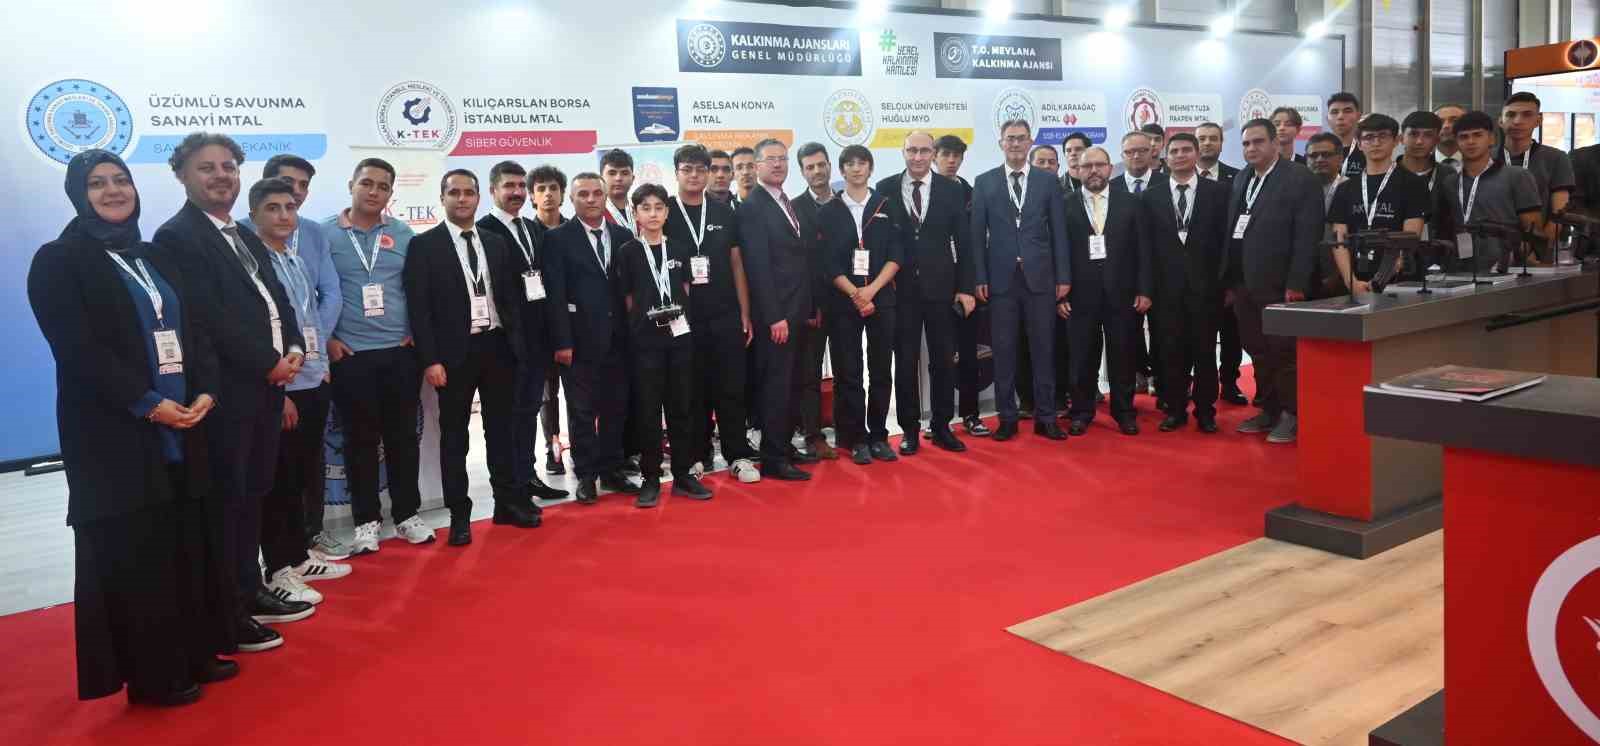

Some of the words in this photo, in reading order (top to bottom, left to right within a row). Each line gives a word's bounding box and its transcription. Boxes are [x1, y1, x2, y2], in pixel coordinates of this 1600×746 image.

[731, 34, 790, 48] KALKINMA
[793, 38, 850, 50] AJANSLARI
[731, 50, 771, 60] GENEL
[991, 46, 1037, 57] MEVLANA
[972, 58, 1021, 68] KALKINMA
[1023, 60, 1053, 70] AJANSI
[149, 94, 220, 108] ÜZÜMLÜ
[223, 97, 305, 109] SAVUNMA
[463, 97, 548, 110] KILIÇARSLAN
[550, 98, 590, 108] BORSA
[693, 101, 739, 110] ASELSAN
[741, 101, 775, 111] KONYA
[881, 102, 912, 112] SELÇUK
[151, 113, 214, 127] SANAYİ
[218, 115, 262, 126] MTAL
[464, 112, 527, 124] İSTANBUL
[530, 114, 563, 124] MTAL
[693, 115, 721, 124] MTAL
[881, 114, 911, 123] HUĞLU
[912, 115, 930, 123] MYO
[397, 130, 440, 139] K-TEK
[465, 136, 497, 148] SİBER
